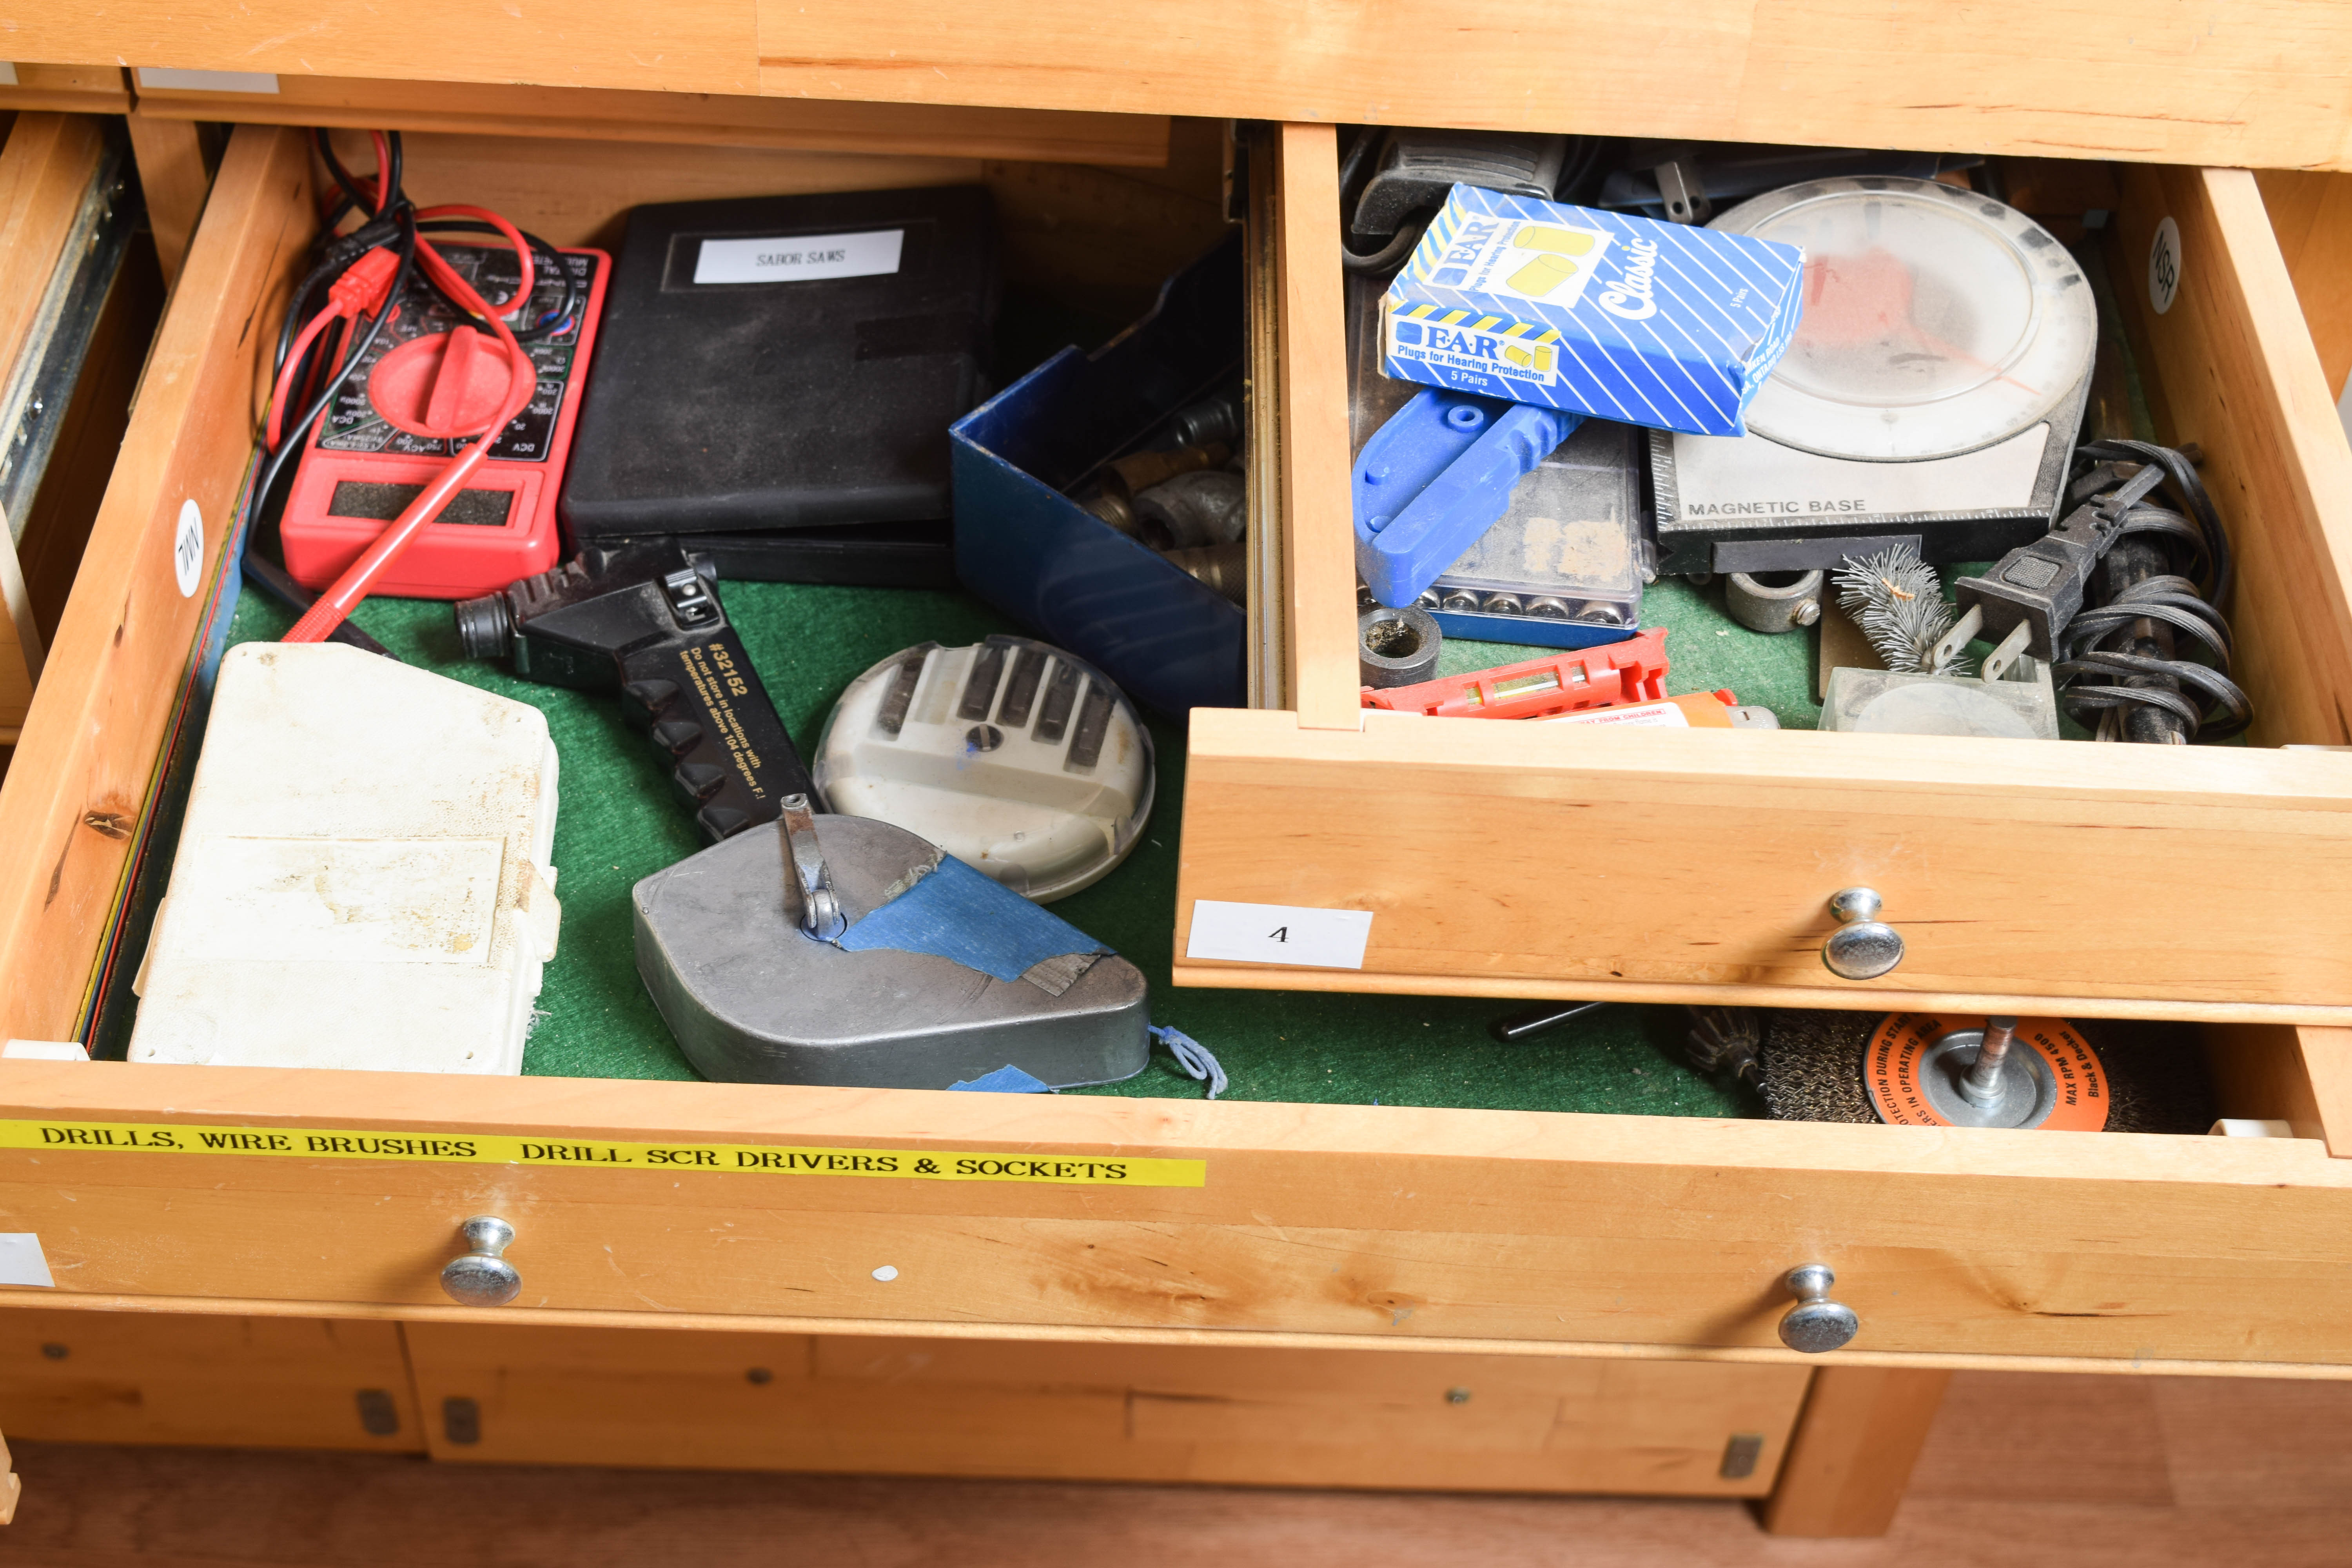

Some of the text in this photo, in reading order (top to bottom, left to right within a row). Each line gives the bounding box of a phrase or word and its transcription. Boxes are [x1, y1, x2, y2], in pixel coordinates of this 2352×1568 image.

[756, 250, 845, 267] SABOR SAWS
[1484, 246, 1506, 267] Hearing
[2152, 230, 2175, 304] NSR
[1469, 276, 1487, 292] Plugs
[1479, 267, 1492, 276] for
[1598, 238, 1658, 320] Classic
[1732, 288, 1749, 304] Pairs
[1398, 345, 1544, 381] Plugs for Hearing Protection
[1451, 371, 1488, 386] 5 Pairs
[332, 416, 354, 424] DCA
[512, 443, 535, 452] DCV
[1689, 500, 1866, 515] MAGNETIC BASE
[708, 642, 748, 697] #32152
[680, 650, 714, 706] temperatures
[710, 708, 728, 733] above
[725, 735, 739, 750] 104
[733, 752, 757, 787] degrees
[691, 647, 762, 769] Do not store in locations with
[1623, 710, 1662, 719] CHILDREN
[1268, 926, 1289, 943] 4
[1915, 1019, 1942, 1040] AREA
[1876, 1039, 1893, 1076] DURING
[1898, 1038, 1919, 1093] OPERATING
[2034, 1033, 2077, 1105] MAX RPM 4500
[2059, 1031, 2099, 1098] Black & Decker
[1877, 1079, 1911, 1125] OTECTION
[1906, 1096, 1920, 1108] IN
[39, 1127, 477, 1158] DRILLS, WIRE BRUSHES
[520, 1143, 1128, 1179] DRILL SCR DRIVERS & SOCKETS
